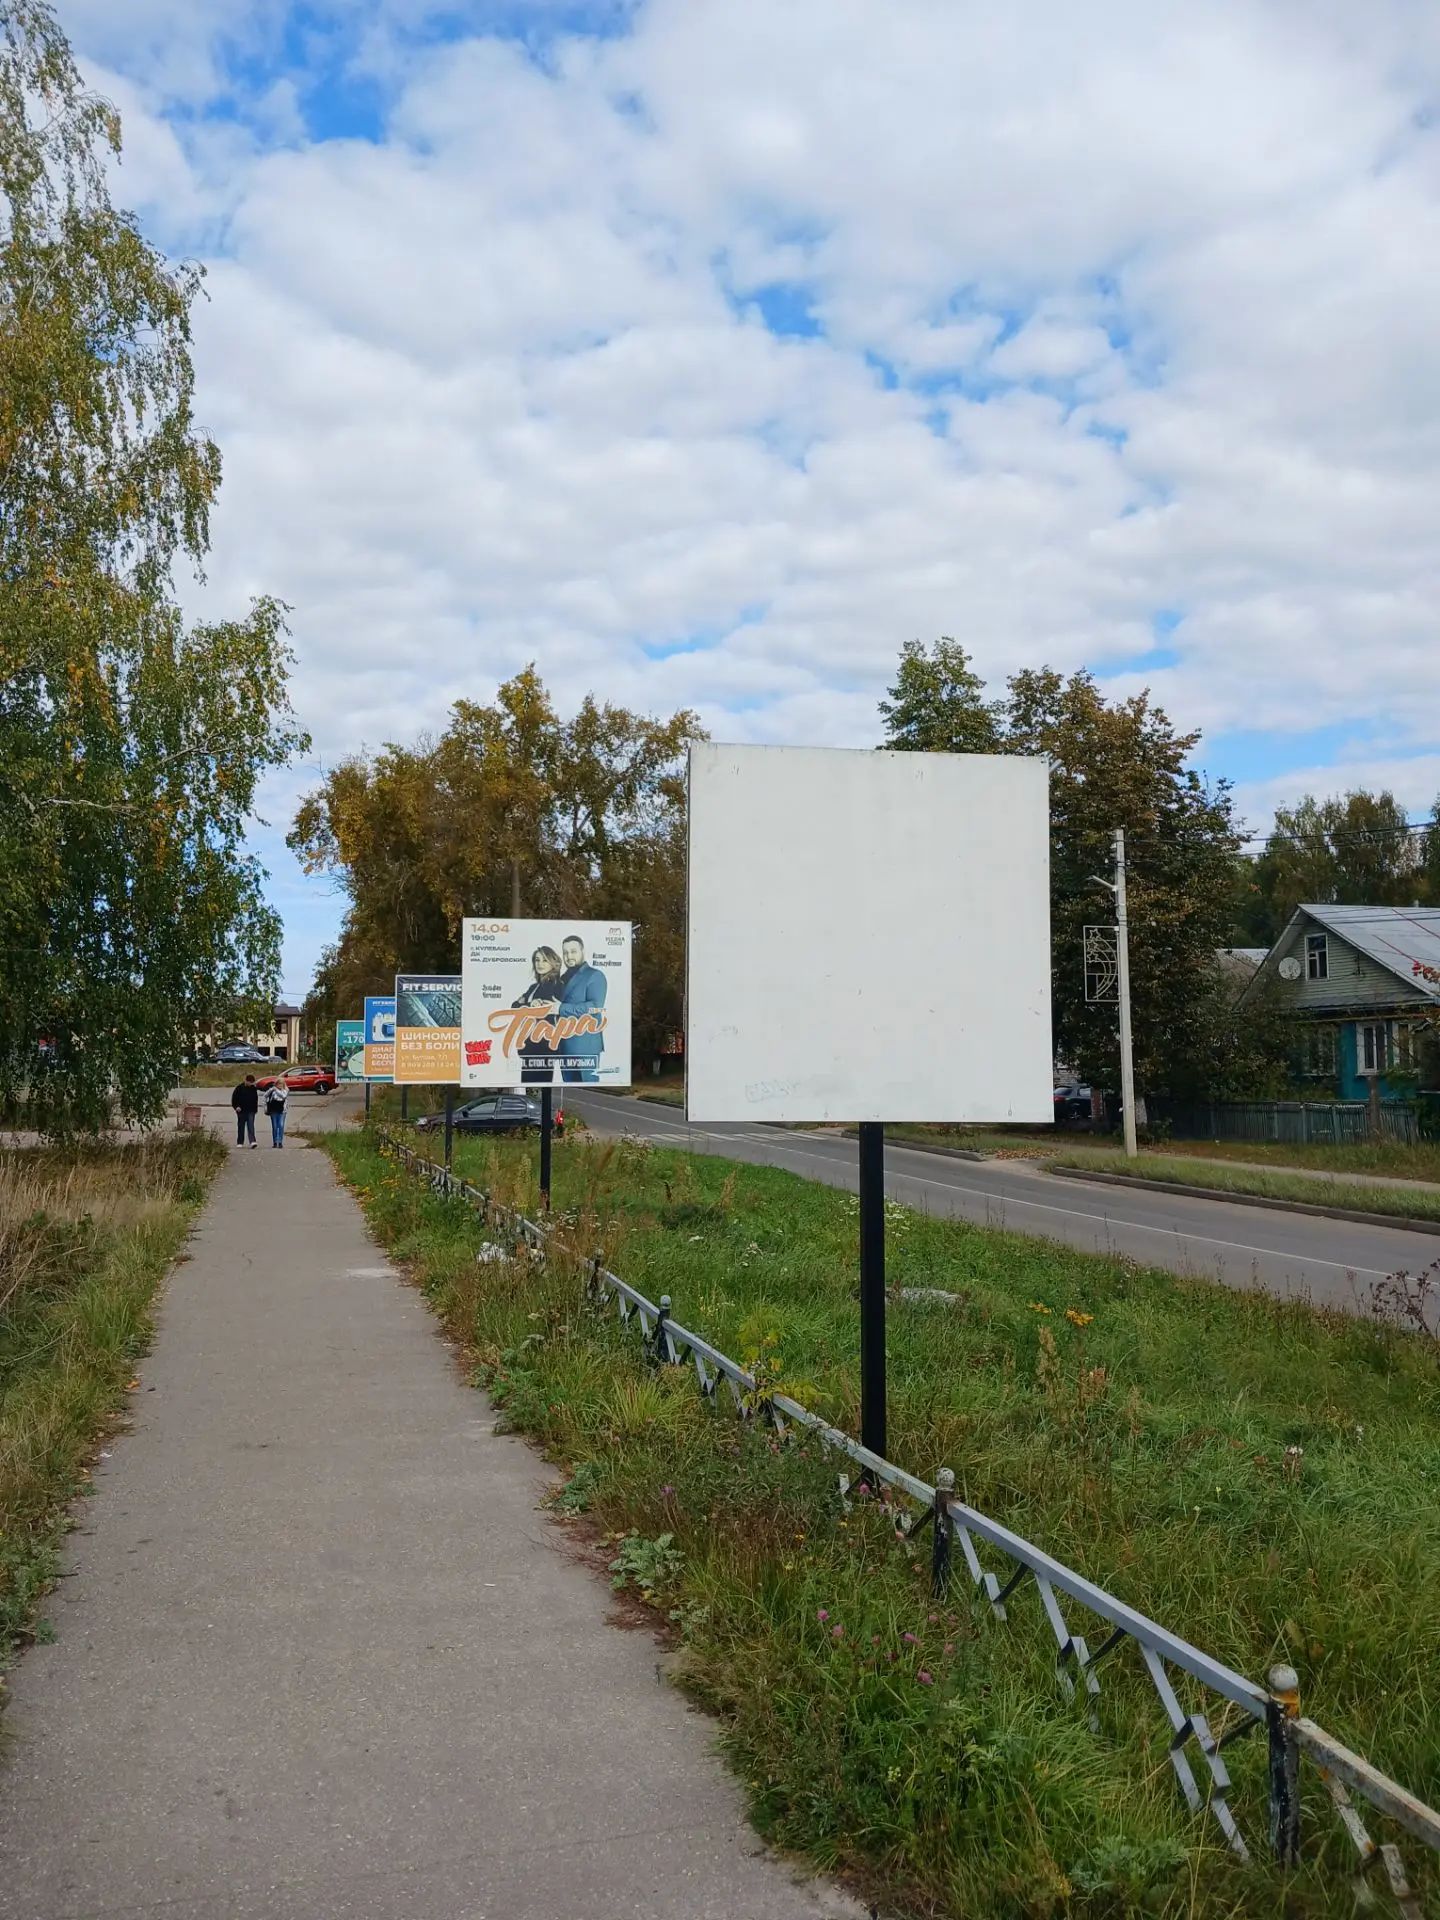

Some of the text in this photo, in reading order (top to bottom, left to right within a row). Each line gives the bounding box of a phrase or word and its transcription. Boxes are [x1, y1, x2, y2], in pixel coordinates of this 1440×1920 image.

[471, 923, 509, 933] 14.04
[402, 983, 421, 991] FIT
[488, 1004, 608, 1058] Пара
[401, 1042, 422, 1050] БЕЗ
[425, 1042, 460, 1050] БОЛИ
[528, 1059, 545, 1067] СТОП,
[567, 1058, 596, 1066] МУЗЫКА
